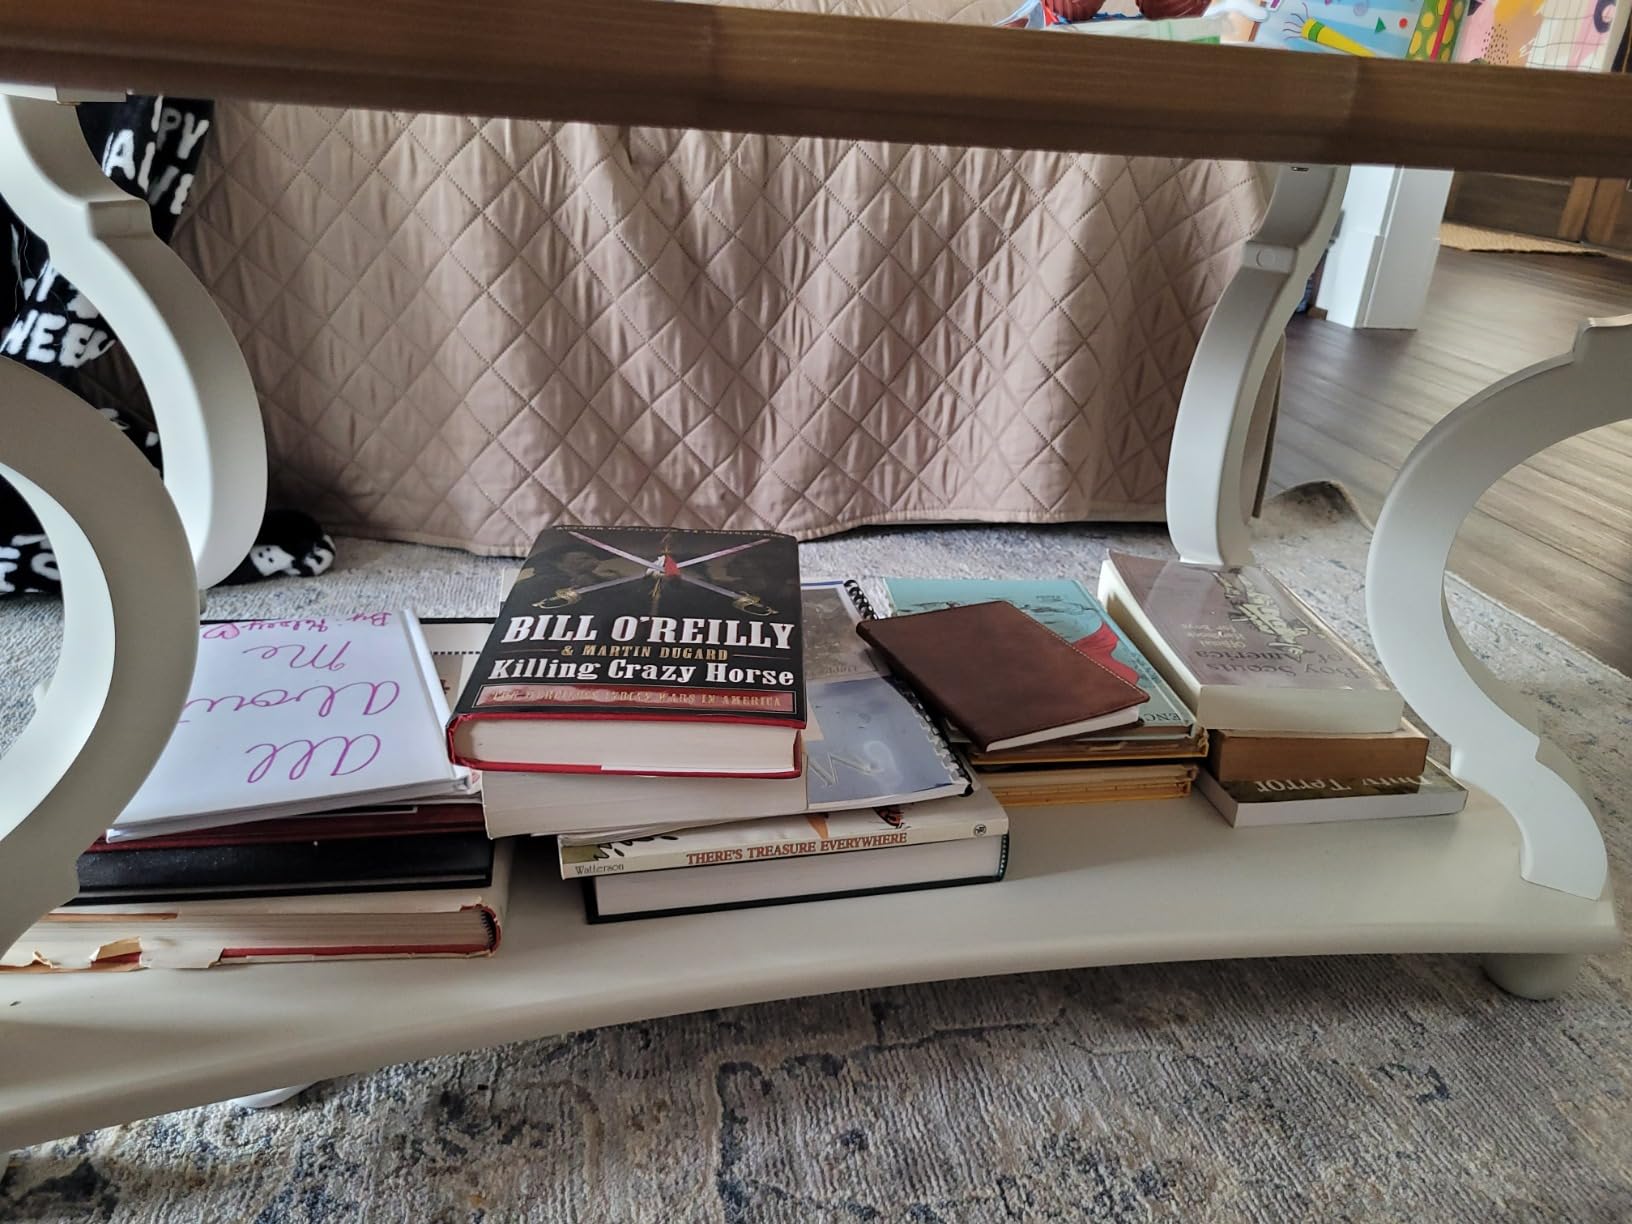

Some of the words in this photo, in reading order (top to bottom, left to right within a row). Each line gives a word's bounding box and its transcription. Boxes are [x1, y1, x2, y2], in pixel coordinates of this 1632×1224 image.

[501, 615, 599, 643] BILL
[611, 615, 795, 650] O'REILLY
[561, 645, 574, 656] &
[582, 645, 652, 658] MARTIN
[659, 647, 729, 661] DUGARD
[1195, 649, 1303, 664] America
[488, 659, 601, 680] Killing
[607, 659, 696, 683] Crazy
[705, 663, 795, 686] Horse
[1205, 663, 1297, 677] Scouts
[178, 680, 400, 723] Abou
[701, 695, 716, 705] IN
[721, 696, 782, 708] AMERICA
[1142, 712, 1181, 722] ENC
[1254, 777, 1353, 793] Terror
[686, 849, 744, 865] THERE'S
[747, 841, 817, 859] TREASURE
[820, 831, 908, 852] EVERYWHERE
[575, 863, 625, 876] Watterson
